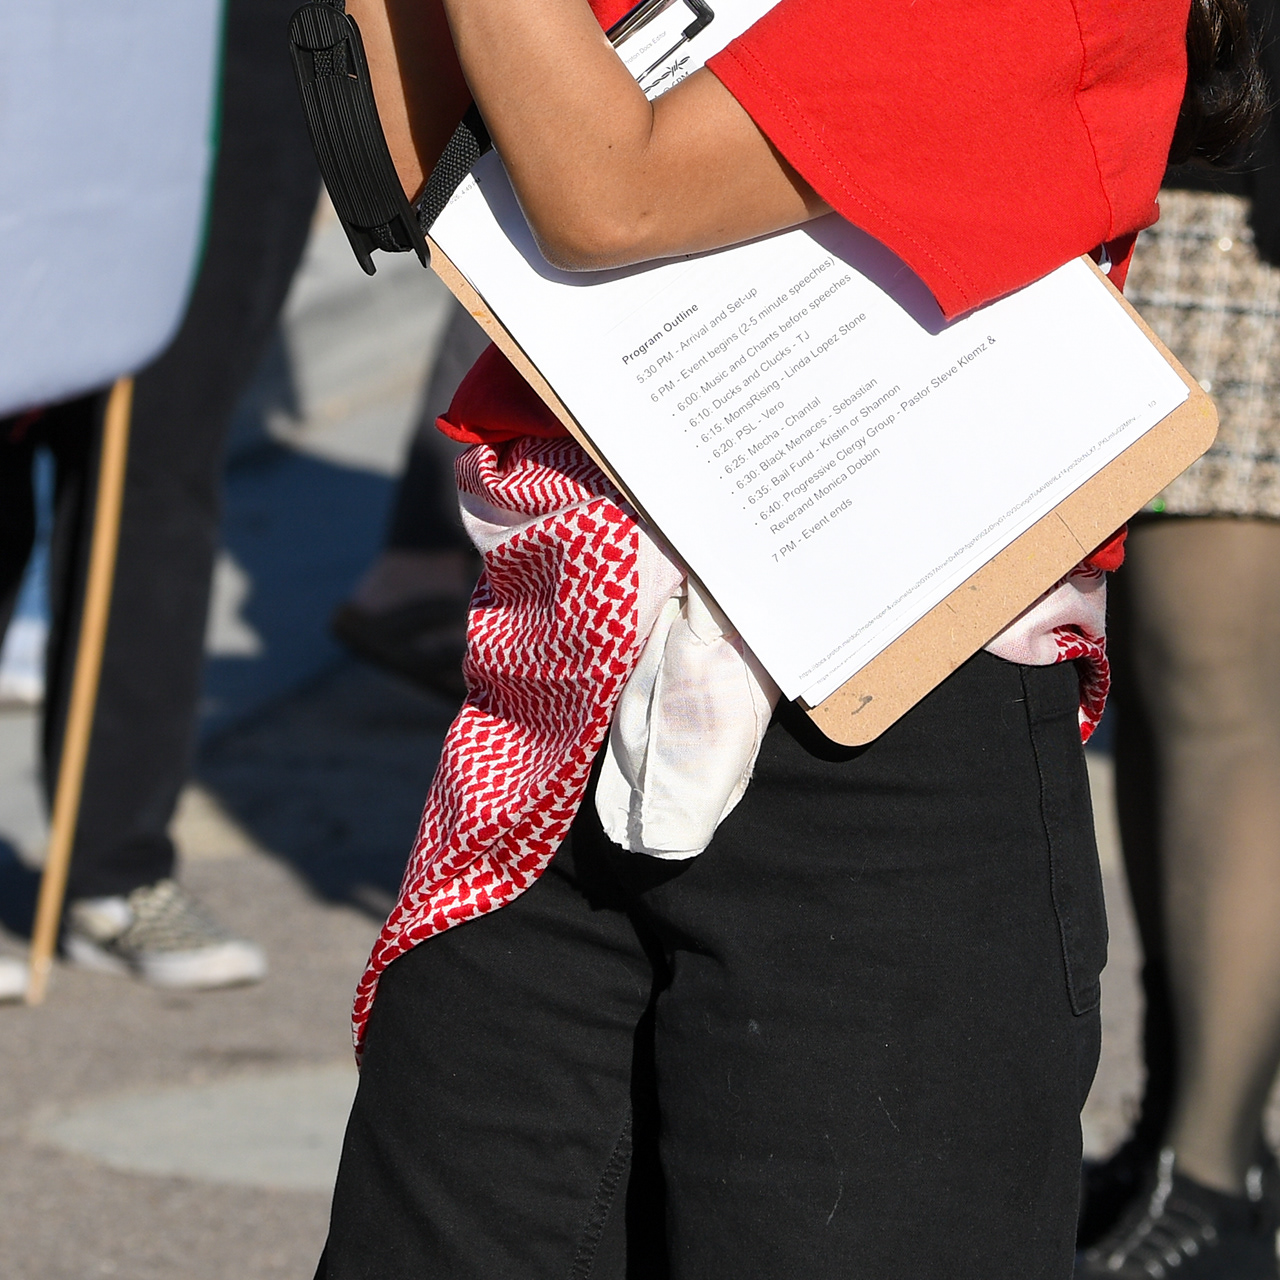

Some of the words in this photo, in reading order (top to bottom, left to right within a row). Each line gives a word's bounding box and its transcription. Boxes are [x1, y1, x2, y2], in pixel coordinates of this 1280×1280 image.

[621, 331, 663, 365] Program
[662, 304, 698, 332] Outline
[636, 364, 657, 383] 5:30
[656, 351, 674, 367] PM
[679, 323, 709, 351] Arrival
[709, 309, 727, 328] and
[726, 287, 757, 313] Set-up
[650, 392, 658, 402] 6
[657, 379, 675, 396] PM
[679, 355, 708, 379] Event
[706, 332, 738, 358] begins
[737, 315, 757, 335] (2-5
[757, 293, 788, 319] minute
[788, 256, 835, 295] speeches)
[676, 391, 701, 411] 6:00:
[699, 370, 728, 393] Music
[728, 353, 746, 372] and
[746, 330, 779, 357] Chants
[778, 308, 808, 332] before
[808, 274, 851, 309] speeches
[700, 422, 725, 442] 6:15:
[723, 380, 780, 425] MomsRising
[783, 356, 811, 377] Linda
[809, 333, 839, 357] Lopez
[838, 312, 866, 335] Stone
[688, 407, 713, 427] 6:10:
[711, 384, 742, 409] Ducks
[742, 368, 760, 386] and
[759, 346, 791, 371] Clucks
[795, 330, 809, 342] TJ
[712, 438, 736, 458] 6:20:
[735, 422, 757, 440] PSL
[760, 401, 784, 418] Vero
[724, 453, 748, 473] 6:25:
[747, 430, 779, 456] Mecha
[784, 396, 821, 426] Chantal
[735, 469, 760, 489] 6:30:
[758, 449, 786, 471] Black
[784, 417, 827, 451] Menaces
[832, 378, 877, 414] Sebastian
[747, 484, 771, 504] 6:35:
[770, 468, 790, 486] Bail
[789, 449, 814, 472] Fund
[818, 424, 849, 448] Kristin
[849, 415, 859, 426] or
[859, 384, 900, 417] Shannon
[759, 500, 783, 520] 6:40:
[782, 459, 836, 502] Progressive
[835, 435, 866, 460] Clergy
[866, 414, 895, 437] Group
[899, 385, 930, 411] Pastor
[930, 366, 958, 388] Steve
[956, 342, 987, 367] Klemz
[986, 335, 996, 344] &
[769, 496, 814, 534] Reverand
[813, 473, 847, 500] Monica
[846, 447, 880, 475] Dobbin
[771, 553, 778, 562] 7
[779, 540, 797, 557] PM
[801, 515, 830, 539] Event
[829, 498, 852, 518] ends
